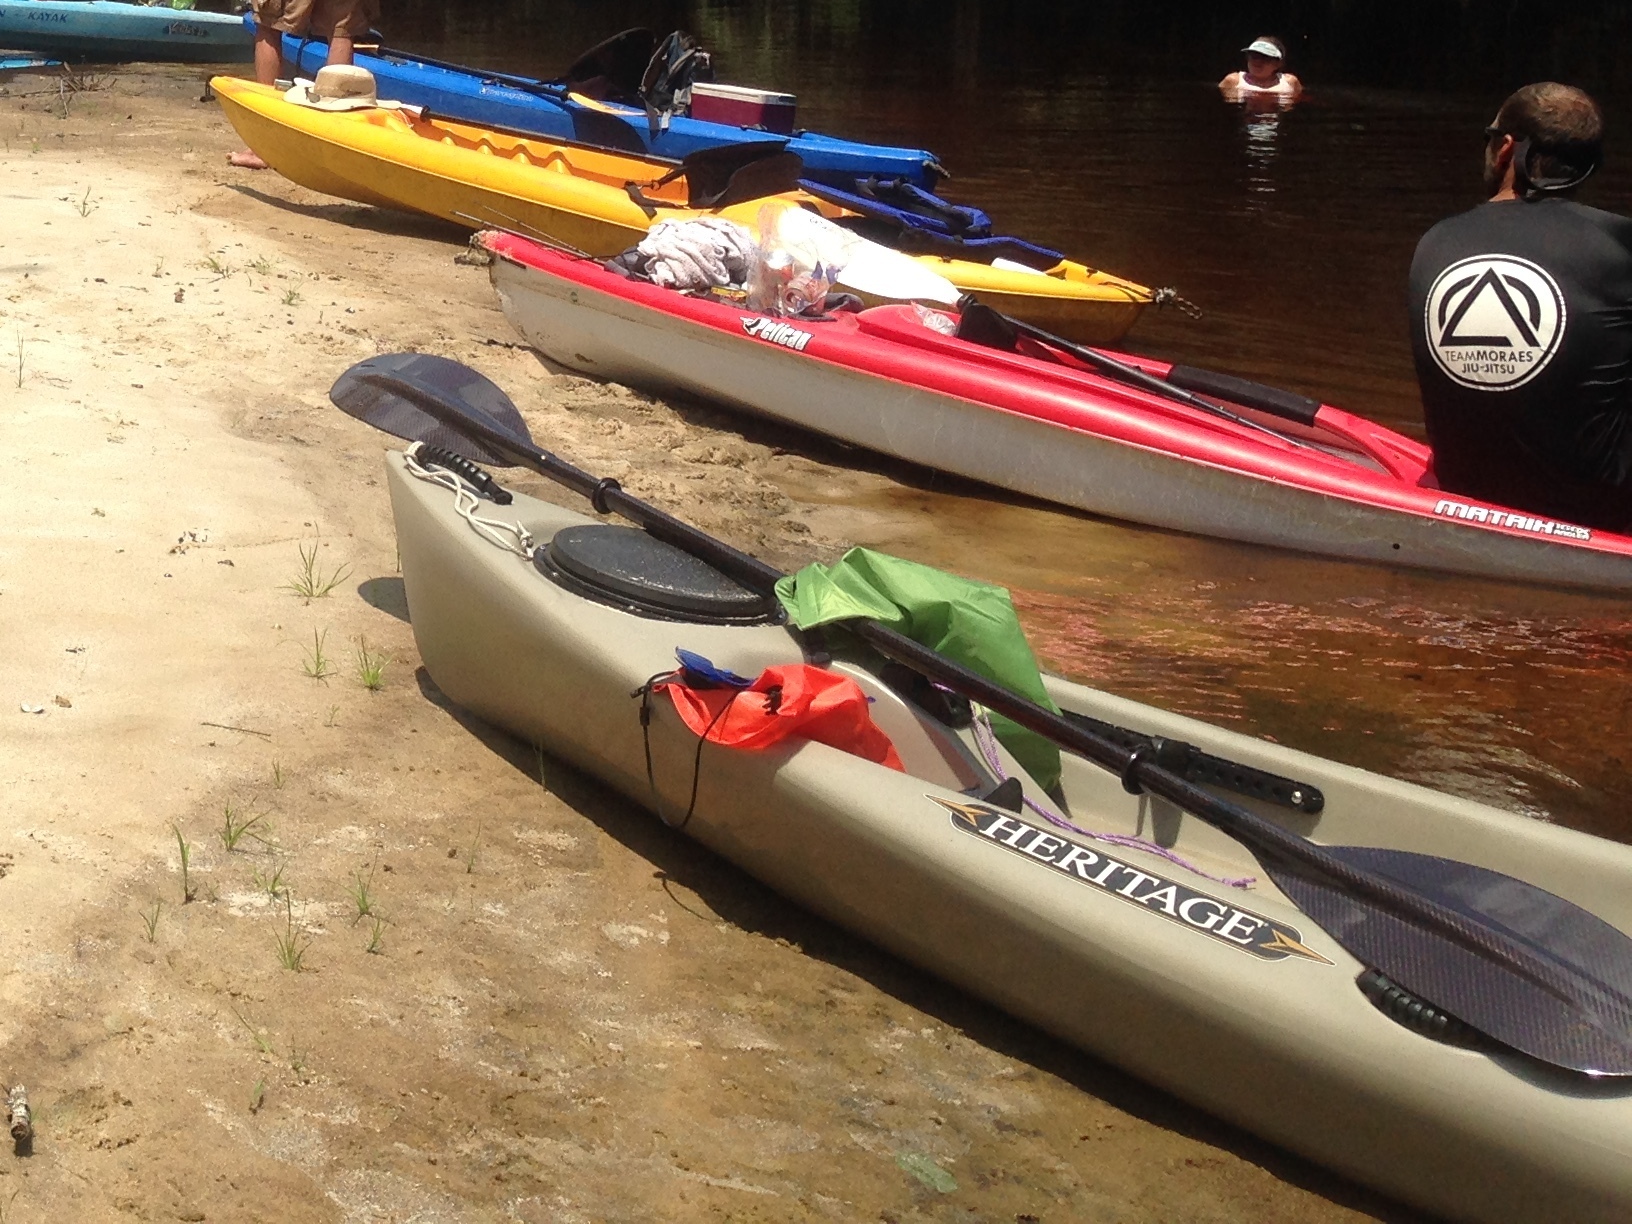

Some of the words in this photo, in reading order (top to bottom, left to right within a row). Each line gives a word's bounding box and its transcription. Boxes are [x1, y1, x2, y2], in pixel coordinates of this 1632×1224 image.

[27, 11, 69, 24] KAYAK
[740, 317, 814, 351] Pelican
[1444, 349, 1534, 363] TEAMMORAES
[1461, 363, 1516, 375] JIU-JITSU
[978, 814, 1267, 946] HERITAGE
